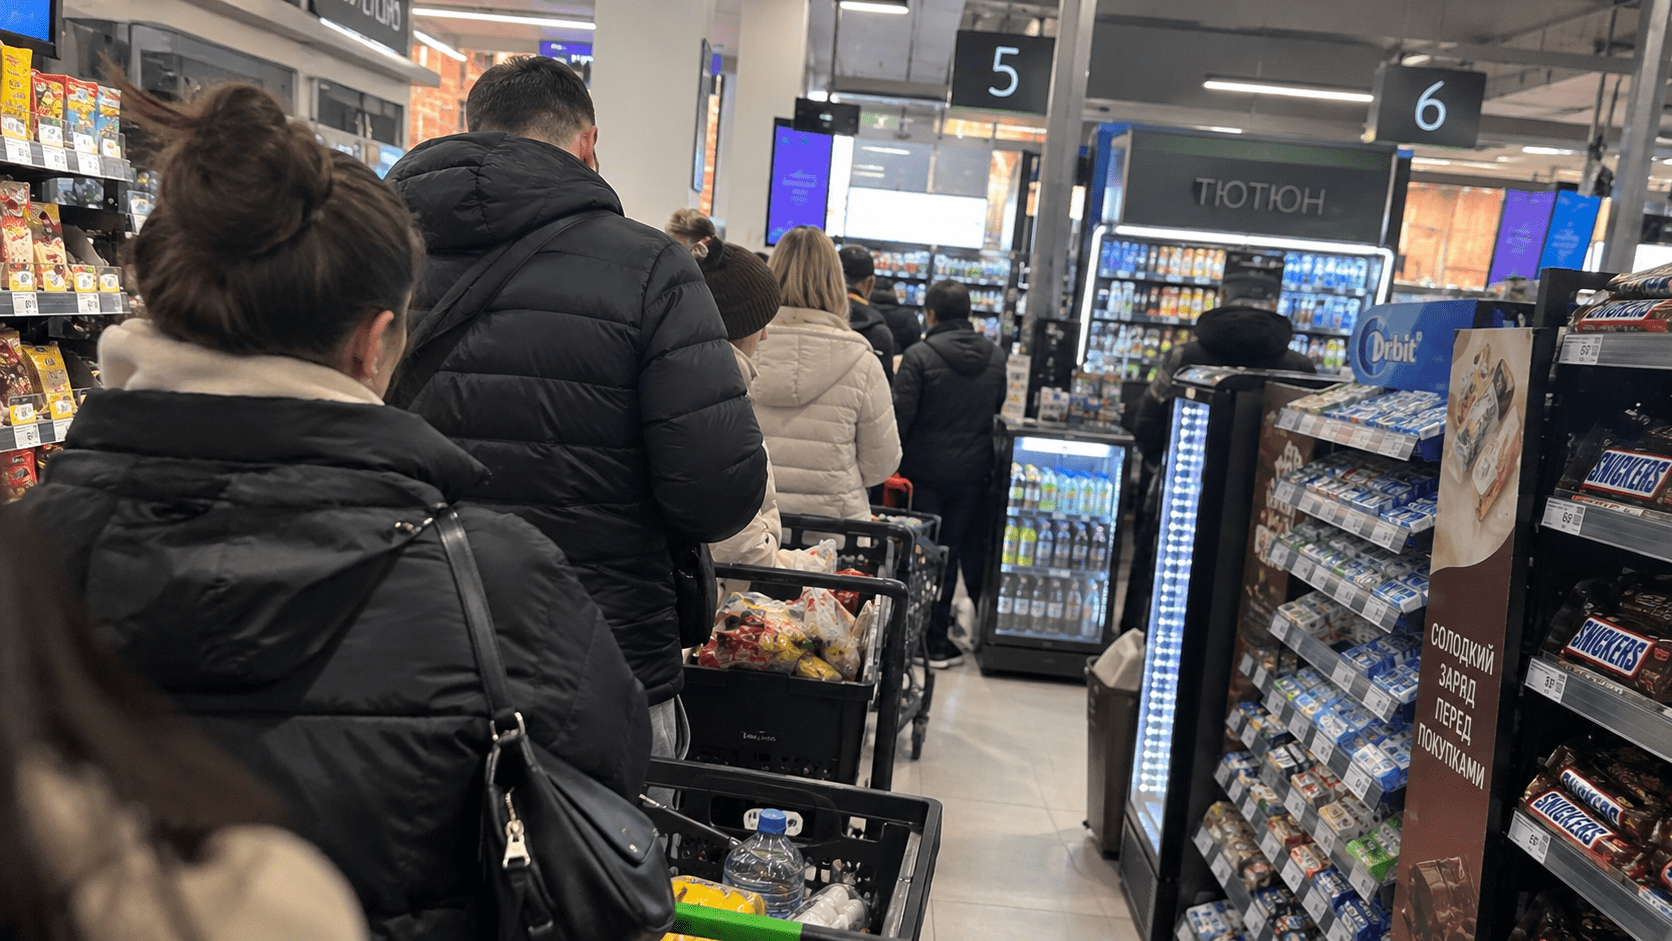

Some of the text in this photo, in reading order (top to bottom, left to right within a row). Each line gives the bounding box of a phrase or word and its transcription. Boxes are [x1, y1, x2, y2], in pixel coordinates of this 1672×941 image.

[988, 46, 1020, 98] 5
[1415, 80, 1447, 132] 6
[1195, 177, 1326, 216] ТЮТЮН
[1586, 451, 1672, 494] SNICKERS
[1431, 622, 1495, 676] СОЛОДКИЙ
[1570, 620, 1648, 672] SNICKERS
[1438, 662, 1477, 710] ЗАРЯД
[1434, 696, 1472, 747] ПЕРЕД
[1417, 722, 1485, 790] ПОКУПКАМИ
[1533, 792, 1608, 846] SNICKERS
